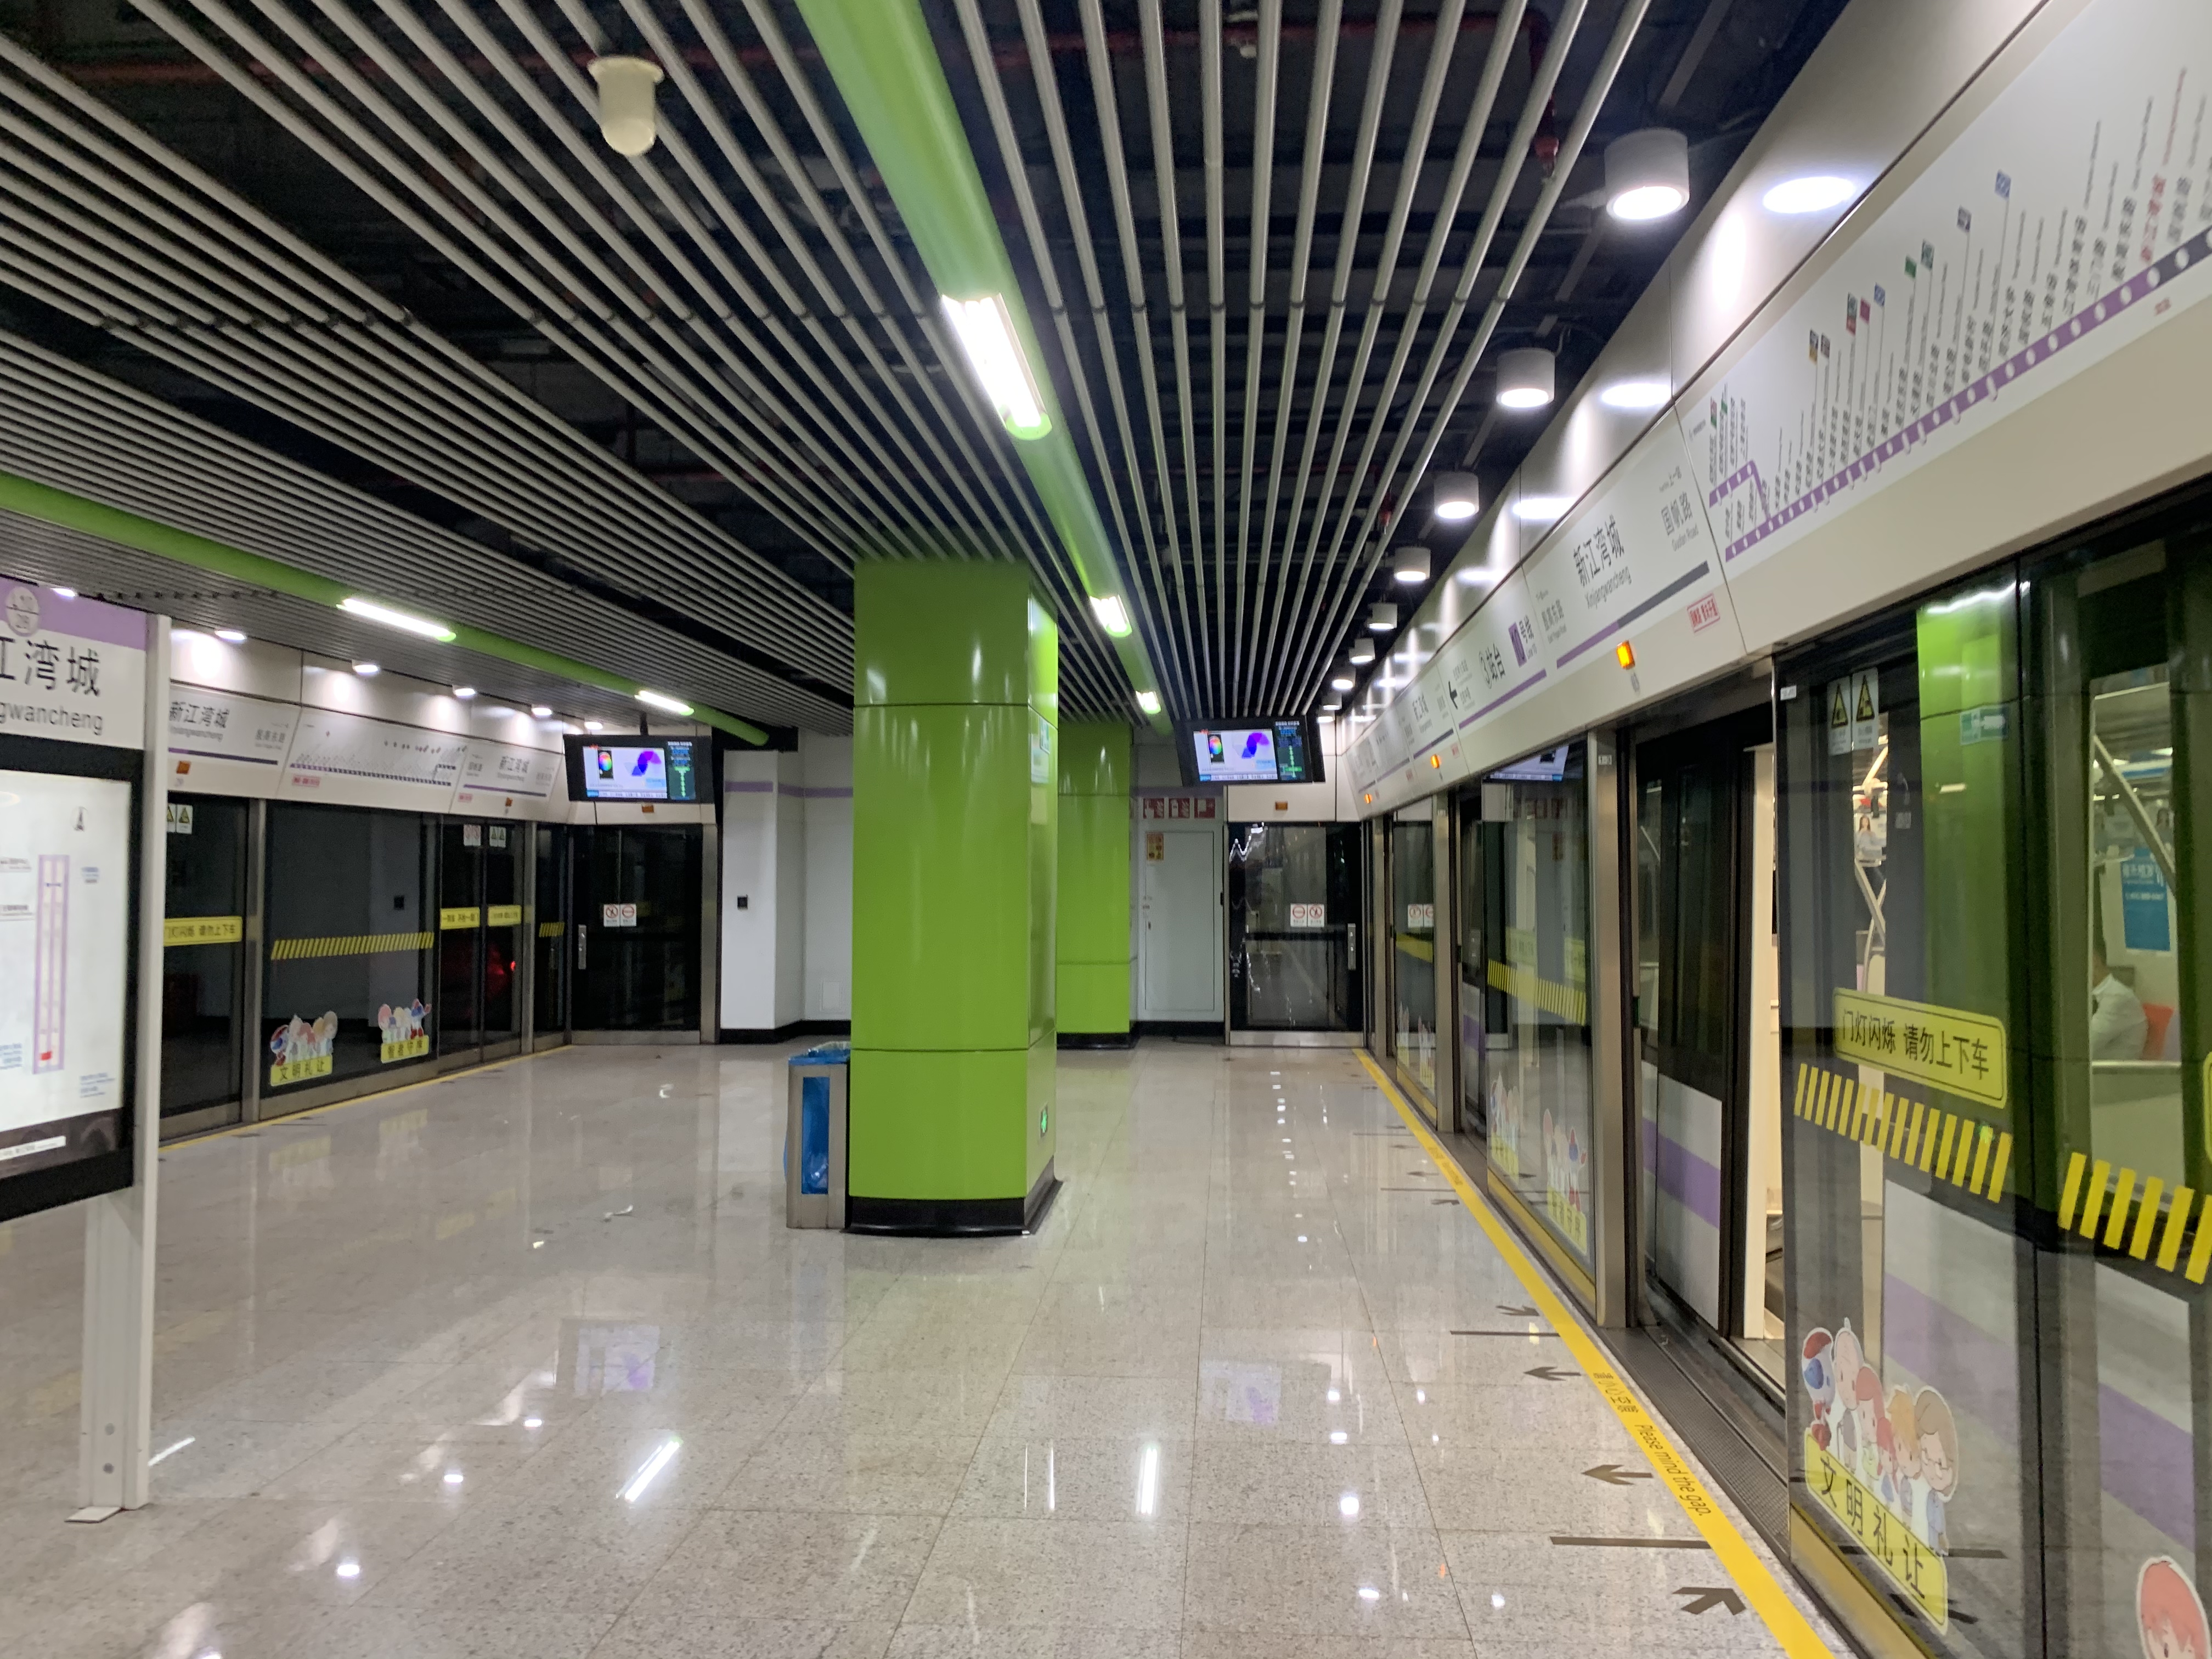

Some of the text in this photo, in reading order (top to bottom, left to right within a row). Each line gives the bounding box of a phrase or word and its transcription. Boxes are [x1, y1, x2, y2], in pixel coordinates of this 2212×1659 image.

[1573, 514, 1624, 588] 新江湾城
[1584, 566, 1632, 610] Xinjiangwancheng
[1842, 1011, 1989, 1080] 门灯闪烁 请勿上下车
[1634, 1424, 1712, 1516] Please mind the gap.
[1820, 1455, 1925, 1599] 文明礼让
